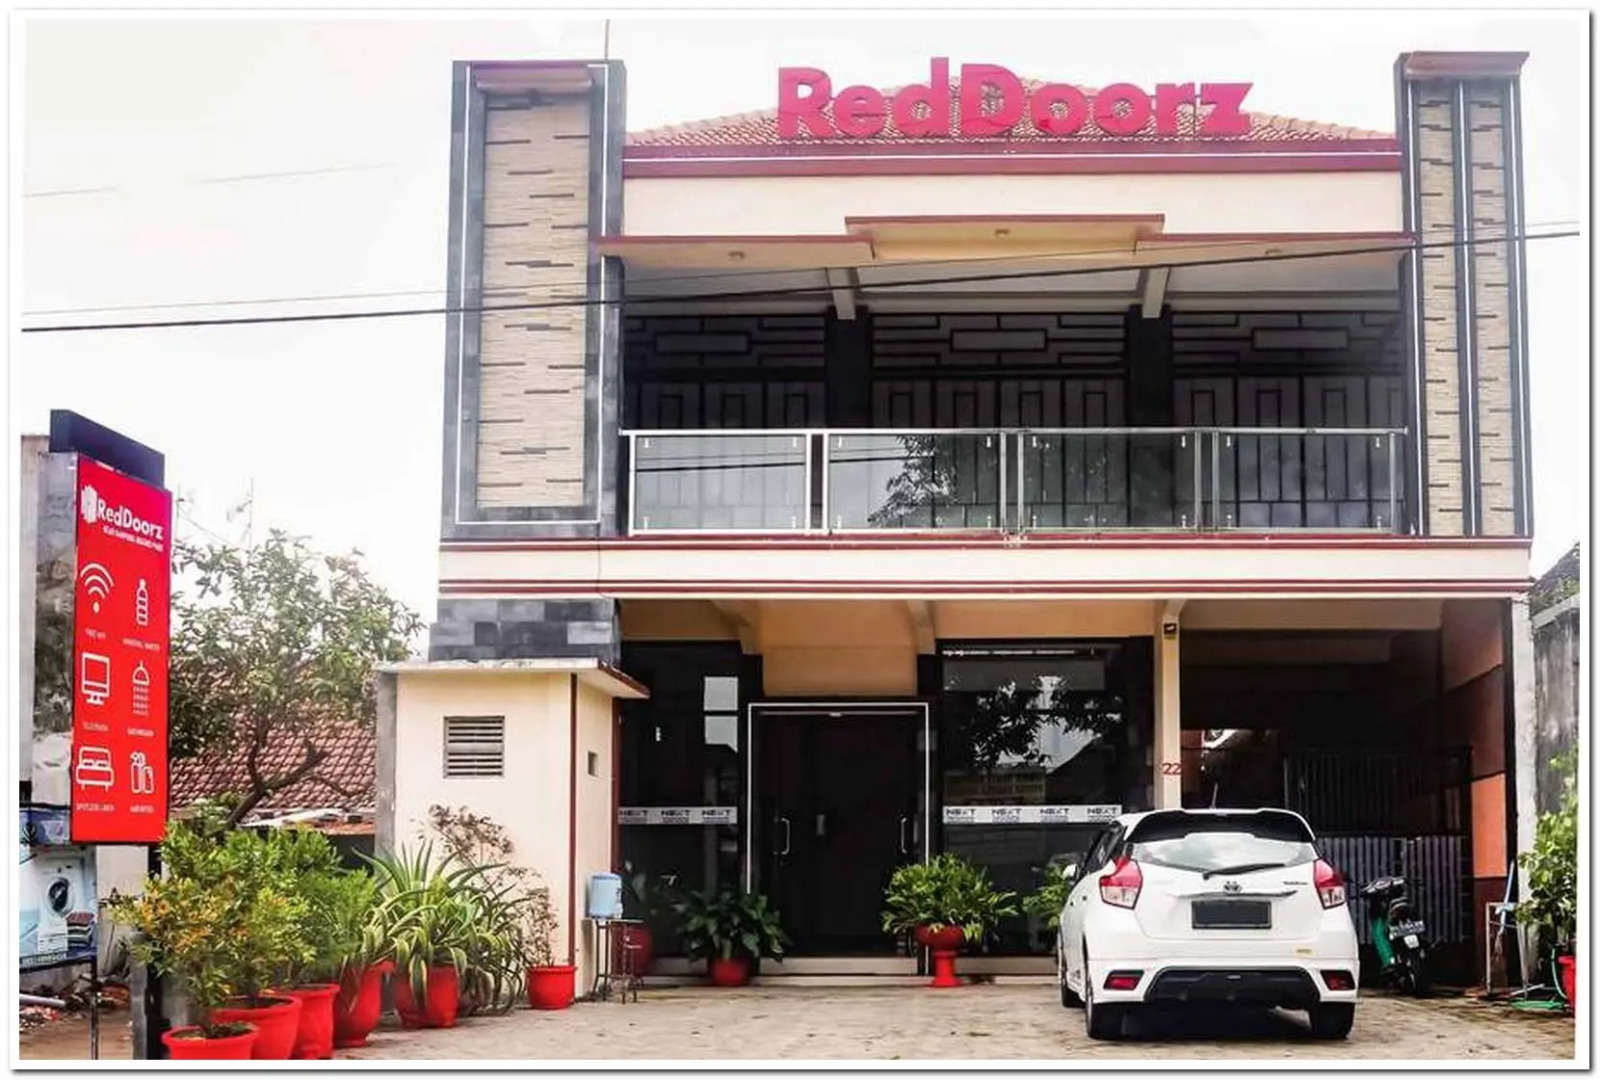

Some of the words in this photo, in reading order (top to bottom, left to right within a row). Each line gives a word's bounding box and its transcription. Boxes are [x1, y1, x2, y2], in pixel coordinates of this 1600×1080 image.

[778, 57, 1254, 139] RedDoorz
[98, 497, 163, 540] RedDoorz
[1162, 762, 1181, 775] 22
